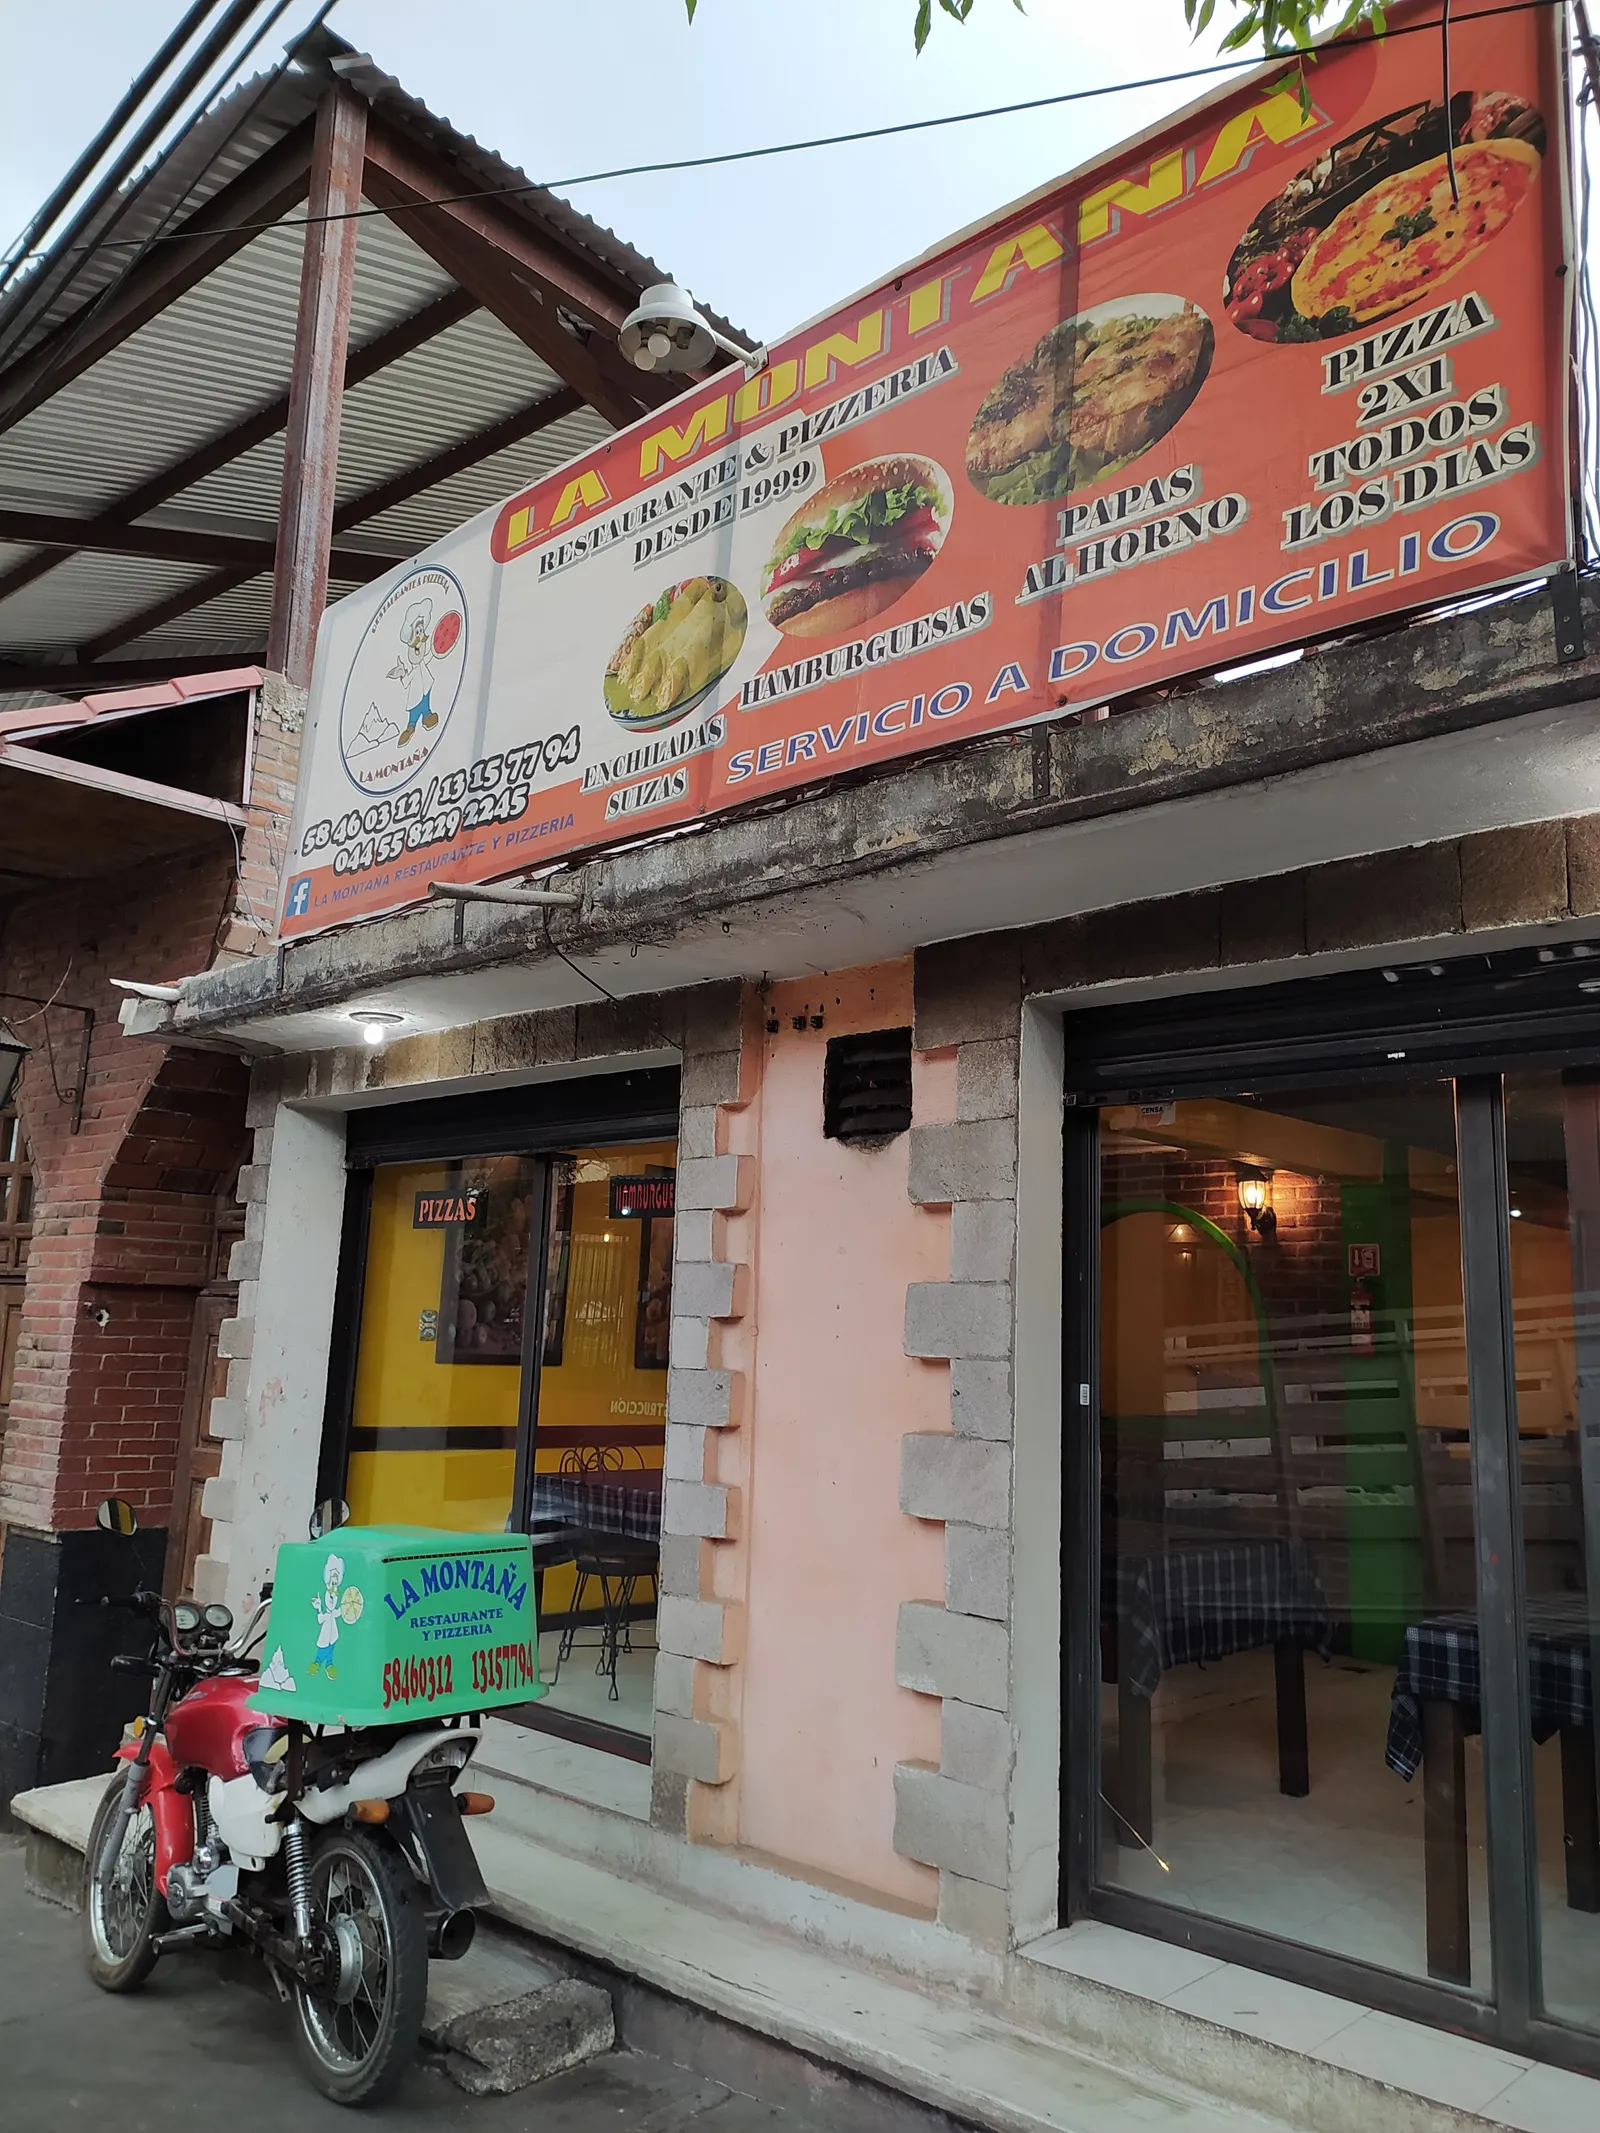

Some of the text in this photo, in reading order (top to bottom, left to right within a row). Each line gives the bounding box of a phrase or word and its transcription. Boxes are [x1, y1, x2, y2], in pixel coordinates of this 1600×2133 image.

[1322, 293, 1494, 391] PIZZA
[537, 347, 957, 578] RESTAURANTE & PIZZERIA
[1310, 385, 1501, 489] TODOS
[507, 469, 607, 549] LA
[634, 460, 813, 566] DESDE 1999
[1060, 464, 1195, 541] PAPAS
[1282, 424, 1535, 548] LOS DIAS
[1017, 495, 1244, 601] AL HORNO
[726, 511, 1501, 784] SERVICIO A DOMICILIO
[741, 593, 990, 708] HAMBURGUESAS
[302, 819, 332, 857] 58
[331, 810, 362, 845] 46
[363, 800, 392, 835] 03
[393, 788, 422, 823] 12
[437, 768, 466, 806] 13
[468, 754, 504, 793] 15
[505, 740, 543, 784] 77
[543, 725, 581, 772] 94
[359, 771, 373, 783] LA
[581, 716, 725, 792] ENCHILADAS
[606, 769, 688, 820] SUIZAS
[314, 894, 328, 907] LA
[394, 840, 486, 881] RESTAURANTE
[492, 836, 503, 851] Y
[505, 813, 575, 848] PIZZERIA
[333, 782, 531, 876] 044 55 8229 2245
[418, 1197, 477, 1222] PIZZAS
[383, 1560, 527, 1620] LA MONTAÑA
[410, 1608, 503, 1628] RESTAURANTE
[422, 1624, 492, 1641] Y PIZZERIA
[383, 1639, 534, 1709] 58460312 13157794
